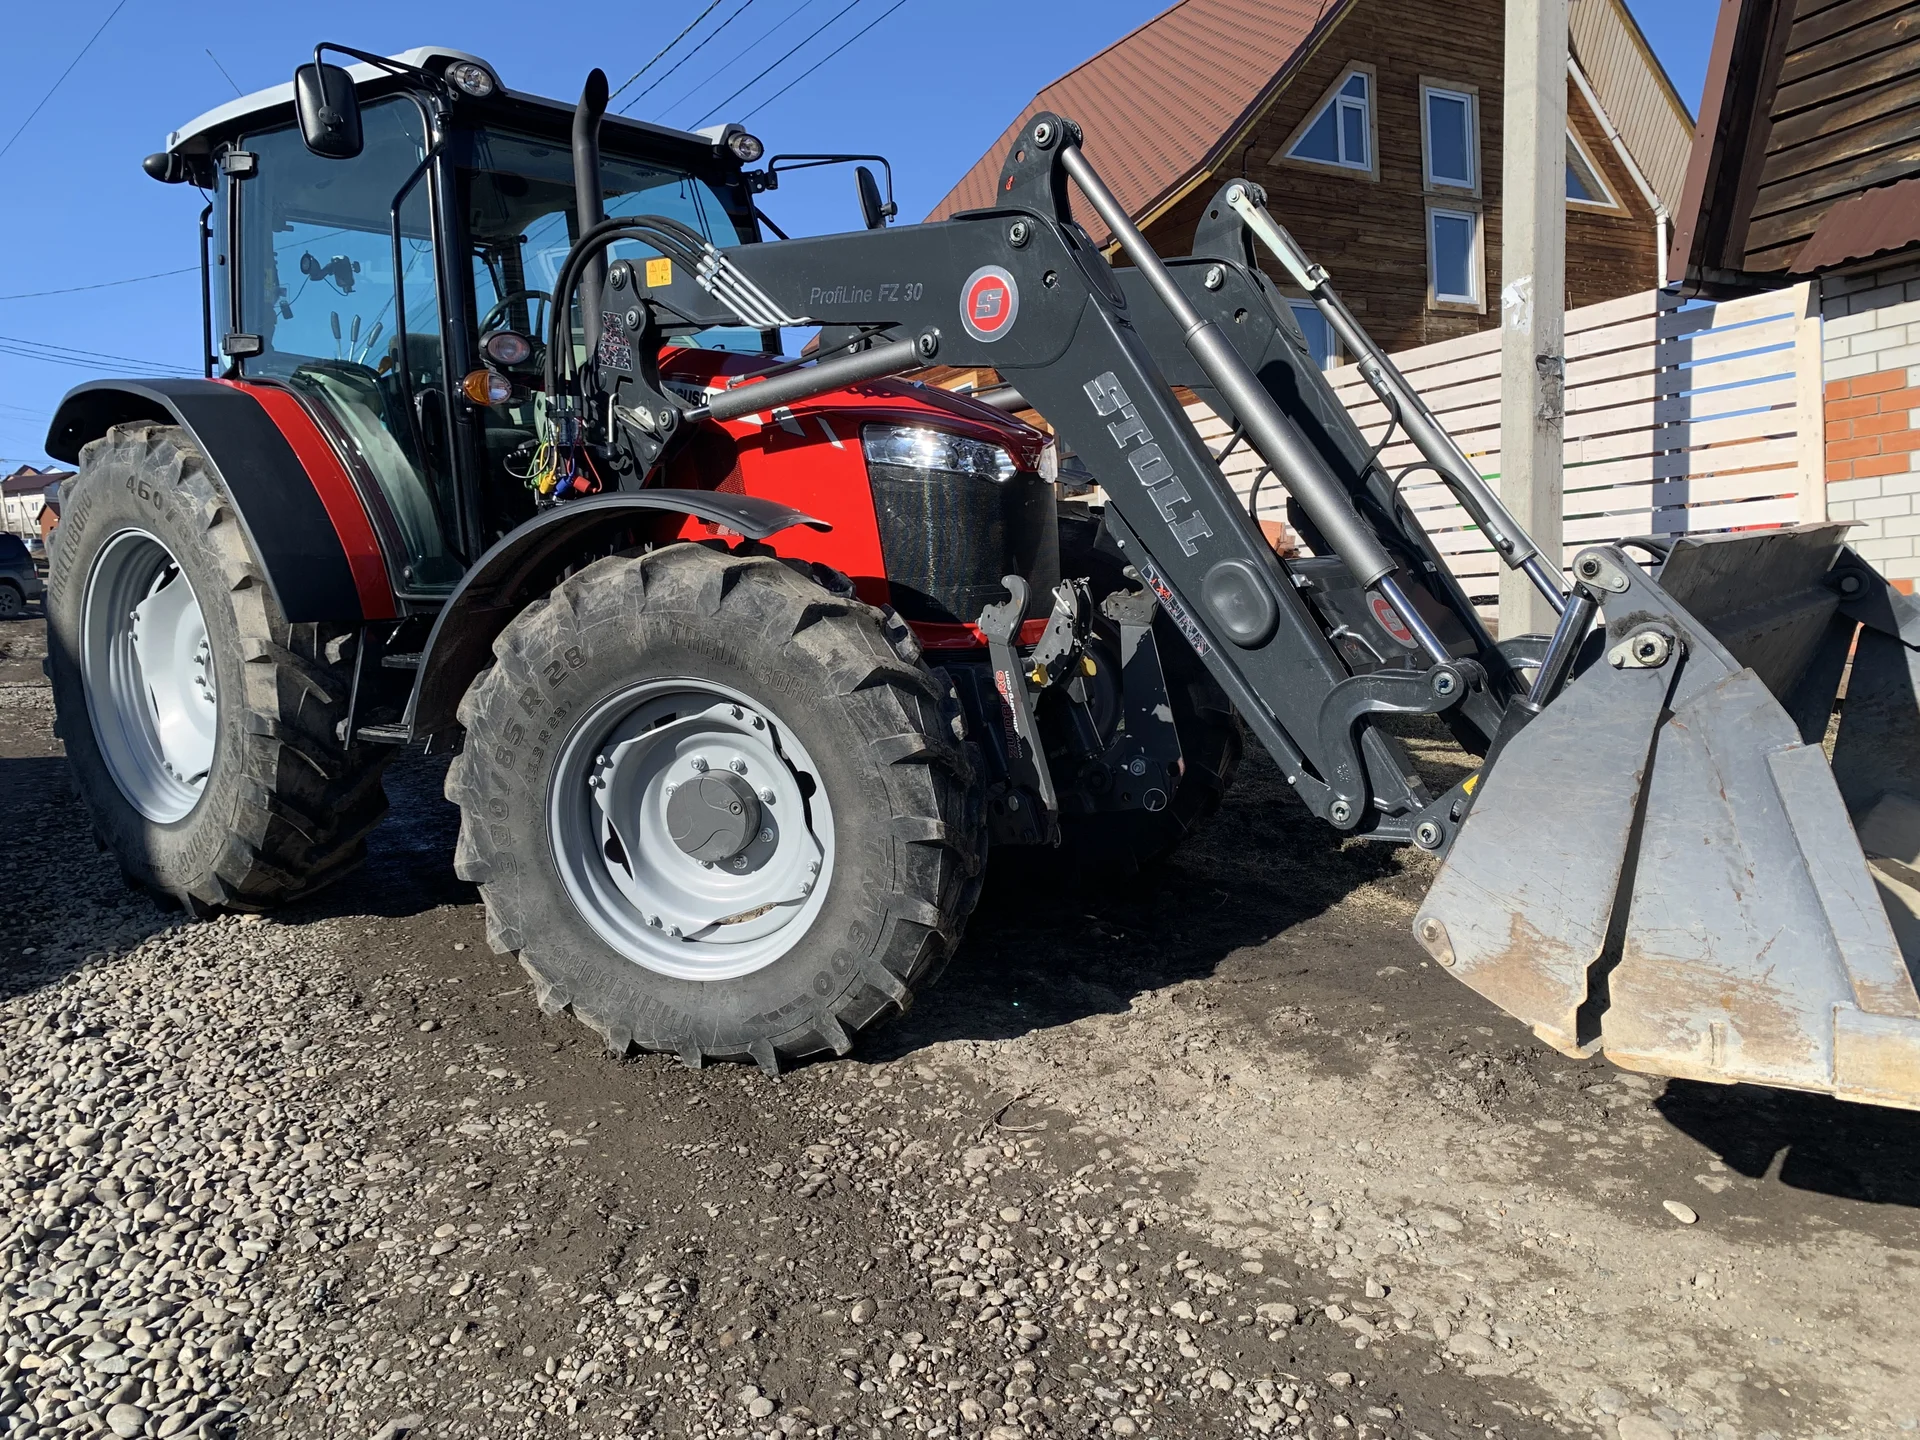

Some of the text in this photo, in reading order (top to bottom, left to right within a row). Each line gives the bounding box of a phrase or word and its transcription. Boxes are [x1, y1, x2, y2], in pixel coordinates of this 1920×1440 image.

[809, 282, 923, 305] ProfiLine FZ 30
[1083, 371, 1214, 558] STOLL
[670, 621, 823, 712] TRELLEBORG
[488, 644, 588, 875] 380/85 R 28
[549, 946, 693, 1038] TRELLEBORG
